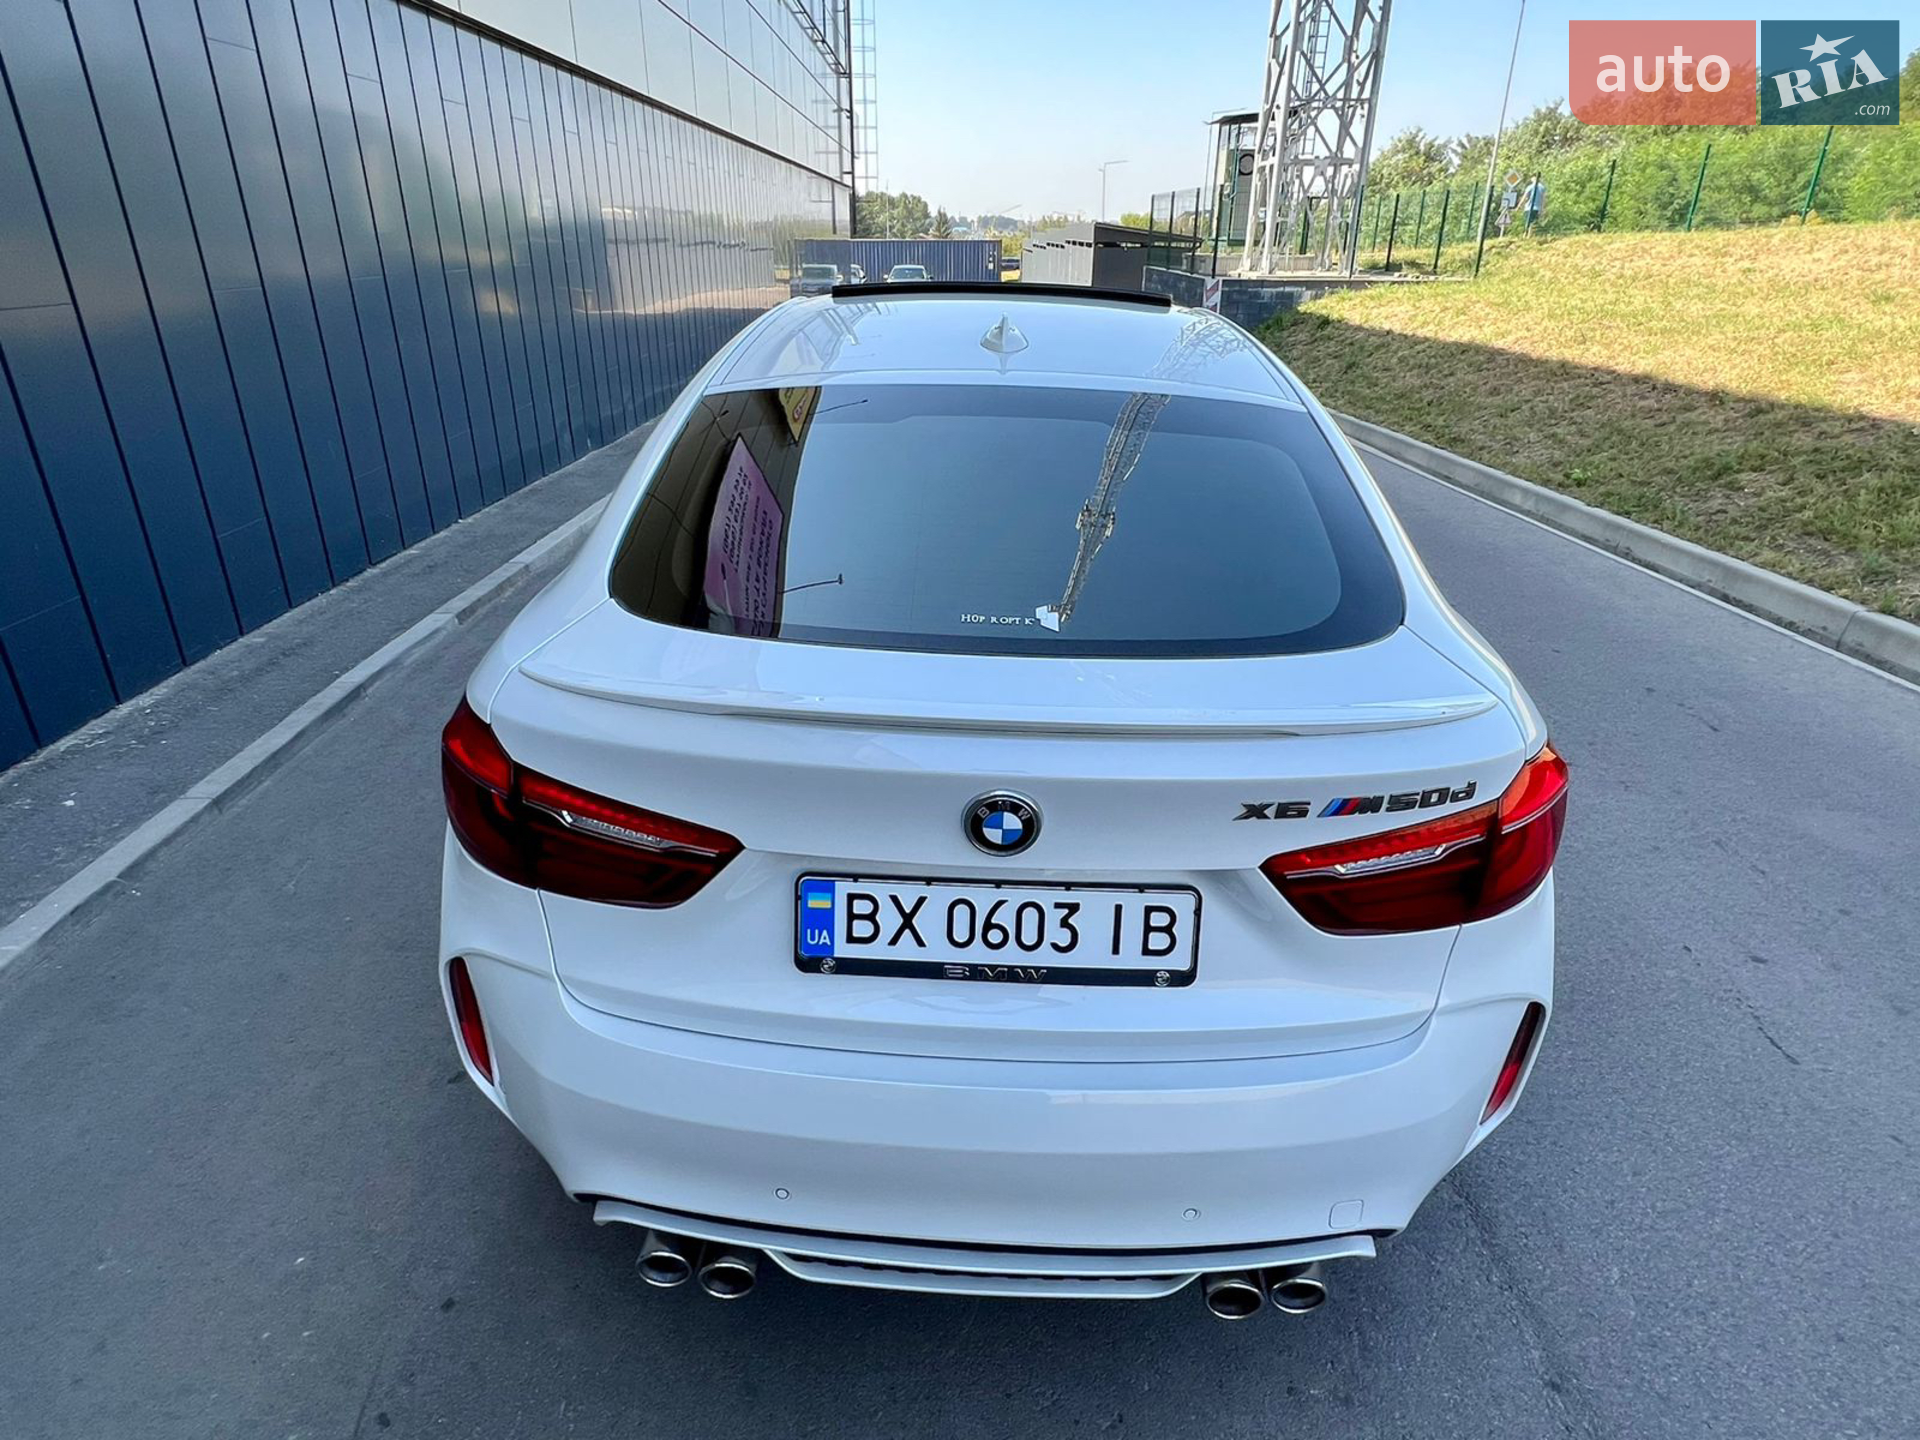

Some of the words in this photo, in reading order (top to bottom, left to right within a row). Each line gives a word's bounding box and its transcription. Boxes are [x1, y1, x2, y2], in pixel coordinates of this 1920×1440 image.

[977, 801, 1031, 820] BMW
[1231, 801, 1312, 821] X6
[845, 892, 927, 948] BX
[946, 897, 1082, 954] 0603
[1111, 903, 1178, 956] IB
[806, 928, 831, 946] UA
[943, 964, 1047, 982] BMW
